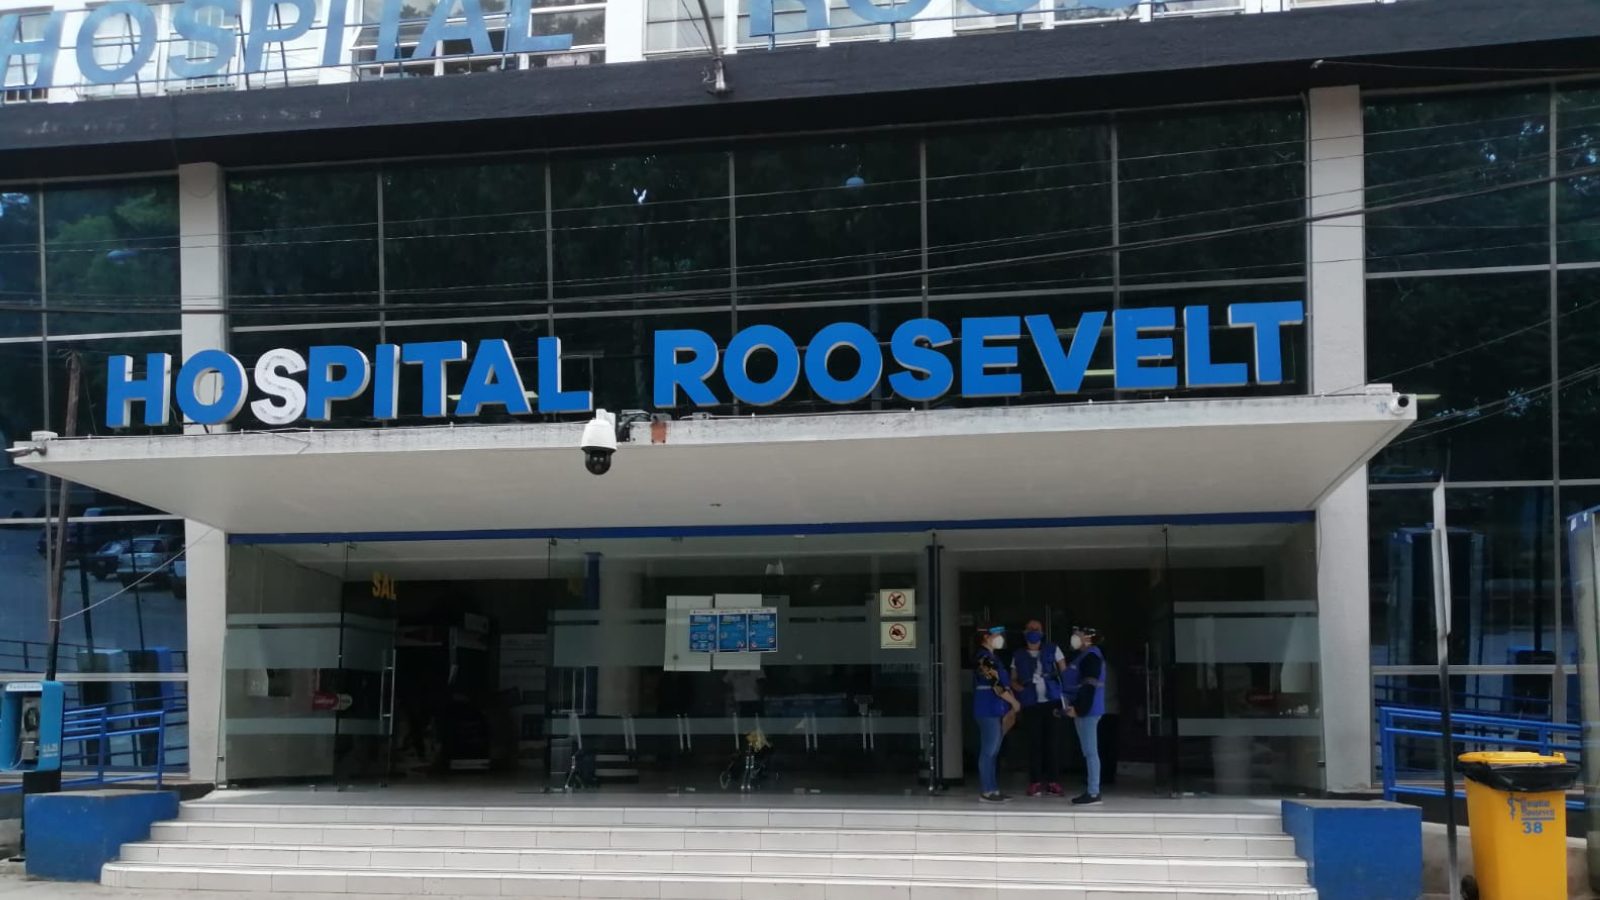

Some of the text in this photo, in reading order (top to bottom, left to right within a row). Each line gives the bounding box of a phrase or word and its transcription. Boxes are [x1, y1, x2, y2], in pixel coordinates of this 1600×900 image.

[105, 301, 1304, 429] HOSPITAL ROOSEVELT
[1522, 822, 1543, 834] 38
